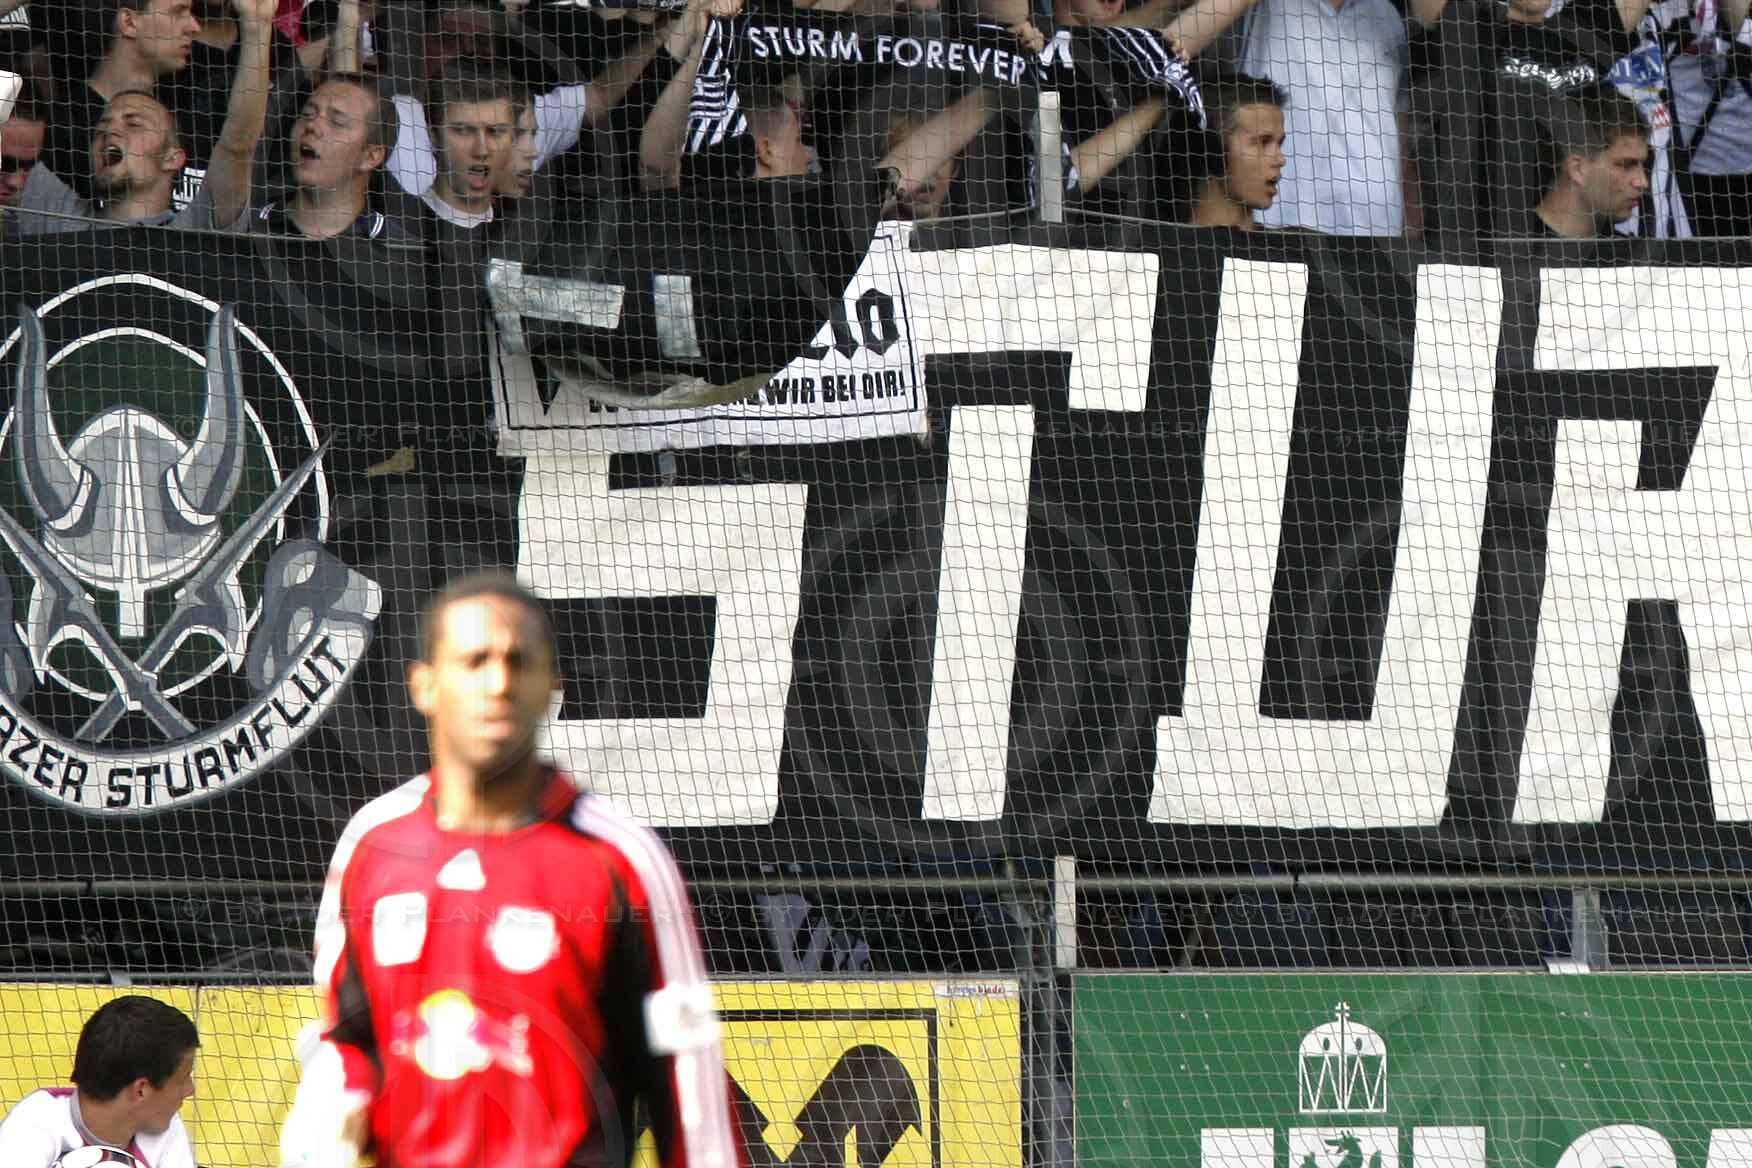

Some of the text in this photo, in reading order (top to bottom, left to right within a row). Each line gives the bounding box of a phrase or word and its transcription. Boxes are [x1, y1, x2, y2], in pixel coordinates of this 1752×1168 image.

[746, 25, 862, 62] STURM
[875, 35, 1029, 86] FOREVER
[821, 374, 858, 404] BEI
[105, 635, 346, 808] STURMFLUT
